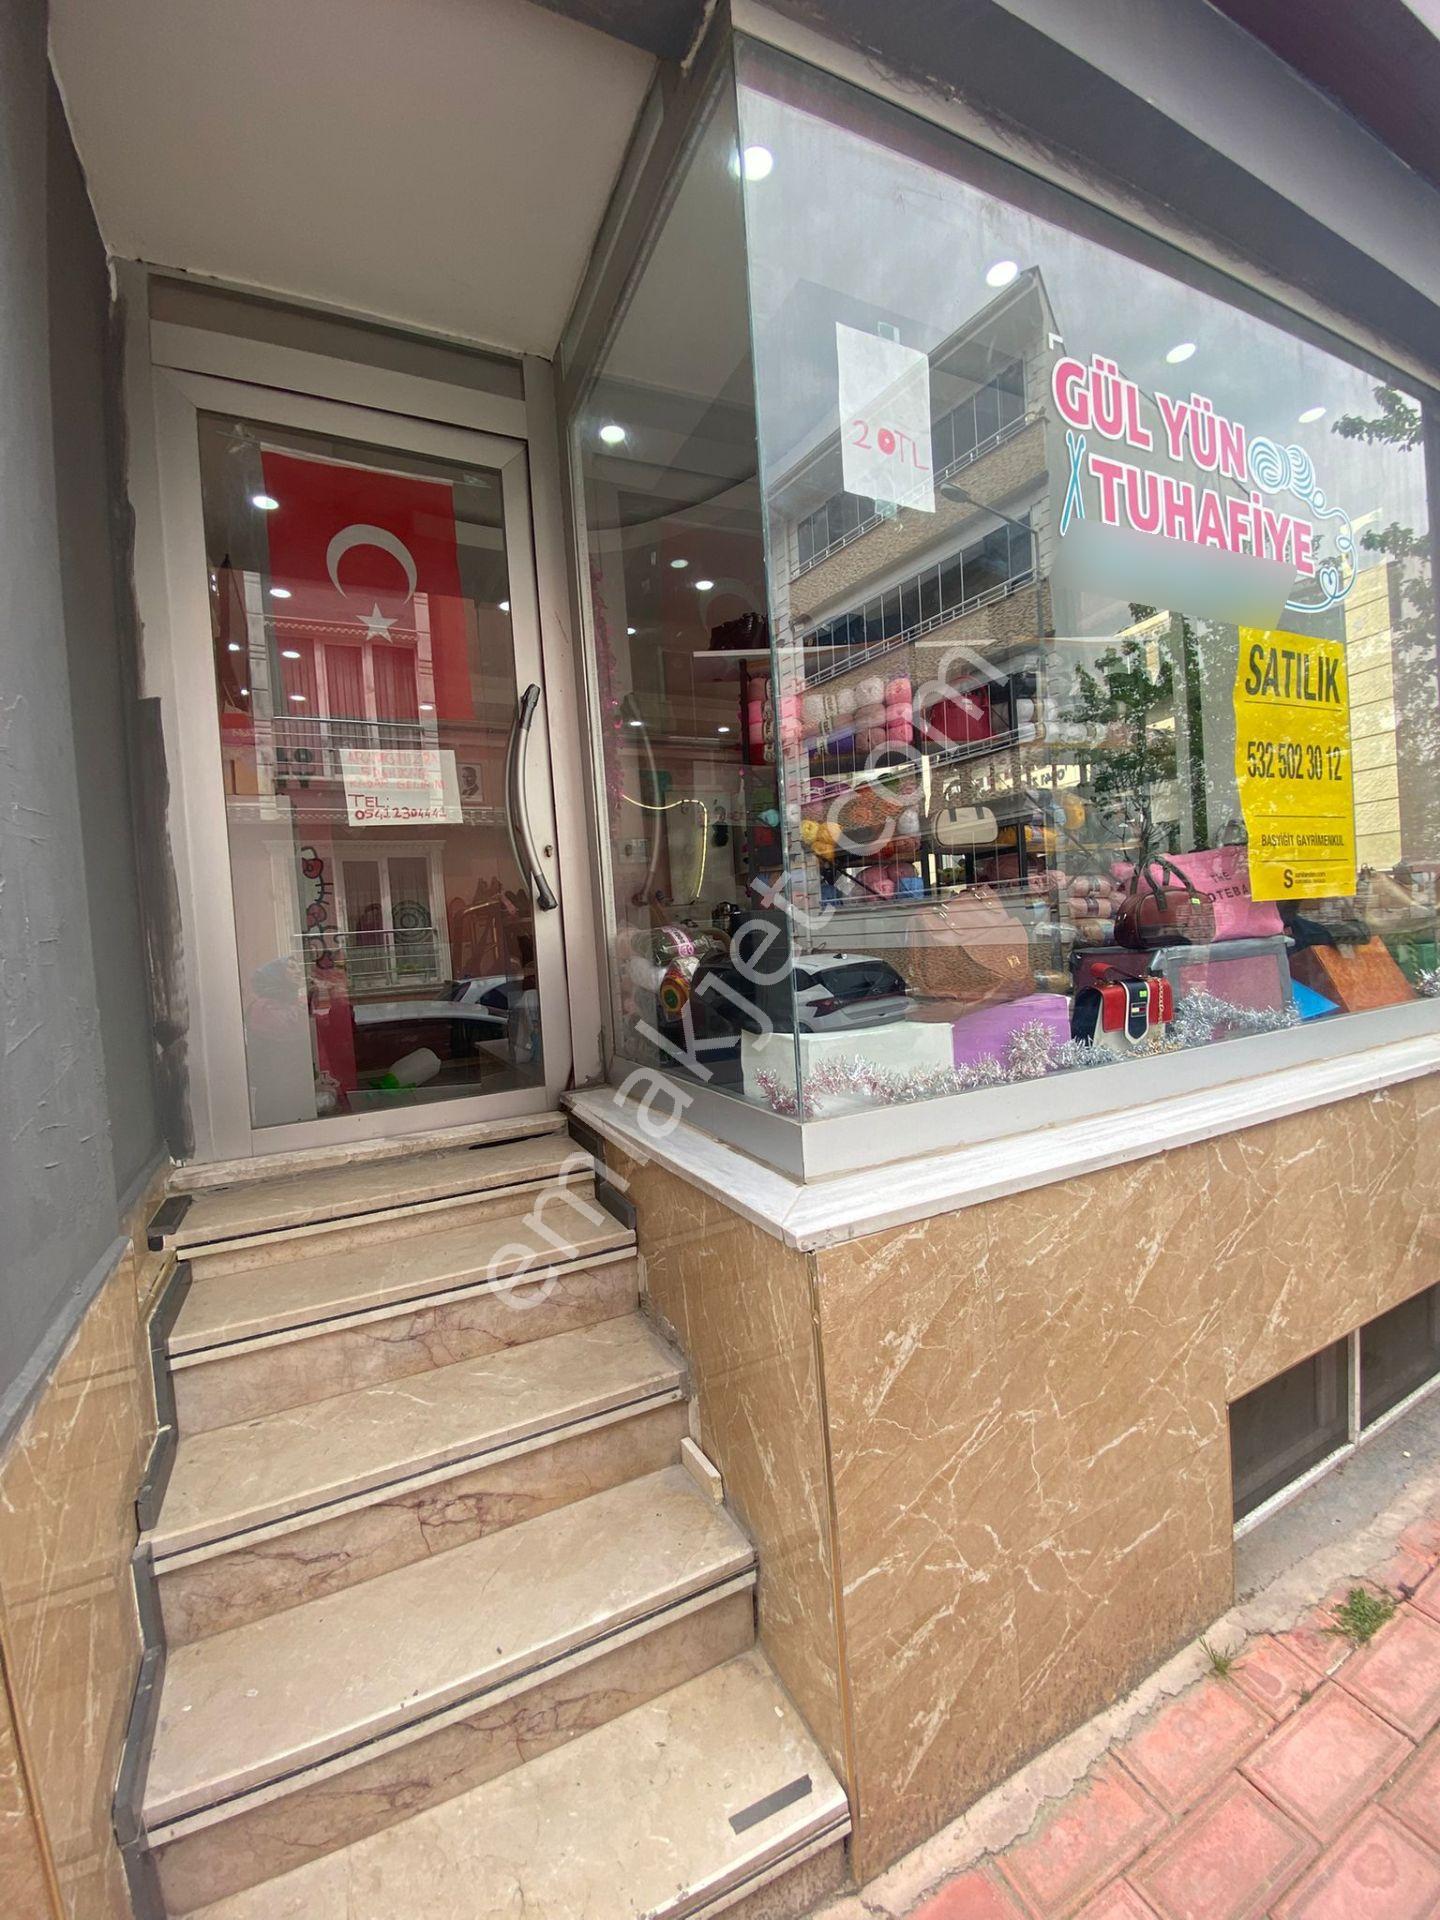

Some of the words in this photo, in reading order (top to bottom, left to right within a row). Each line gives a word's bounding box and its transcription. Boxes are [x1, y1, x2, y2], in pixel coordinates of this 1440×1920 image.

[1052, 353, 1153, 452] GÜL
[1154, 392, 1249, 483] YÜN
[1089, 453, 1316, 577] TUHAFİYE
[1245, 643, 1341, 704] SATILIK
[1247, 741, 1275, 778] 532
[1278, 743, 1304, 780] 502
[1307, 744, 1323, 781] 30
[1326, 746, 1343, 781] 12
[1296, 833, 1345, 847] GAYRİMENKUL
[1210, 871, 1232, 883] THE
[1284, 868, 1293, 889] S
[1207, 884, 1249, 903] OTEBA
